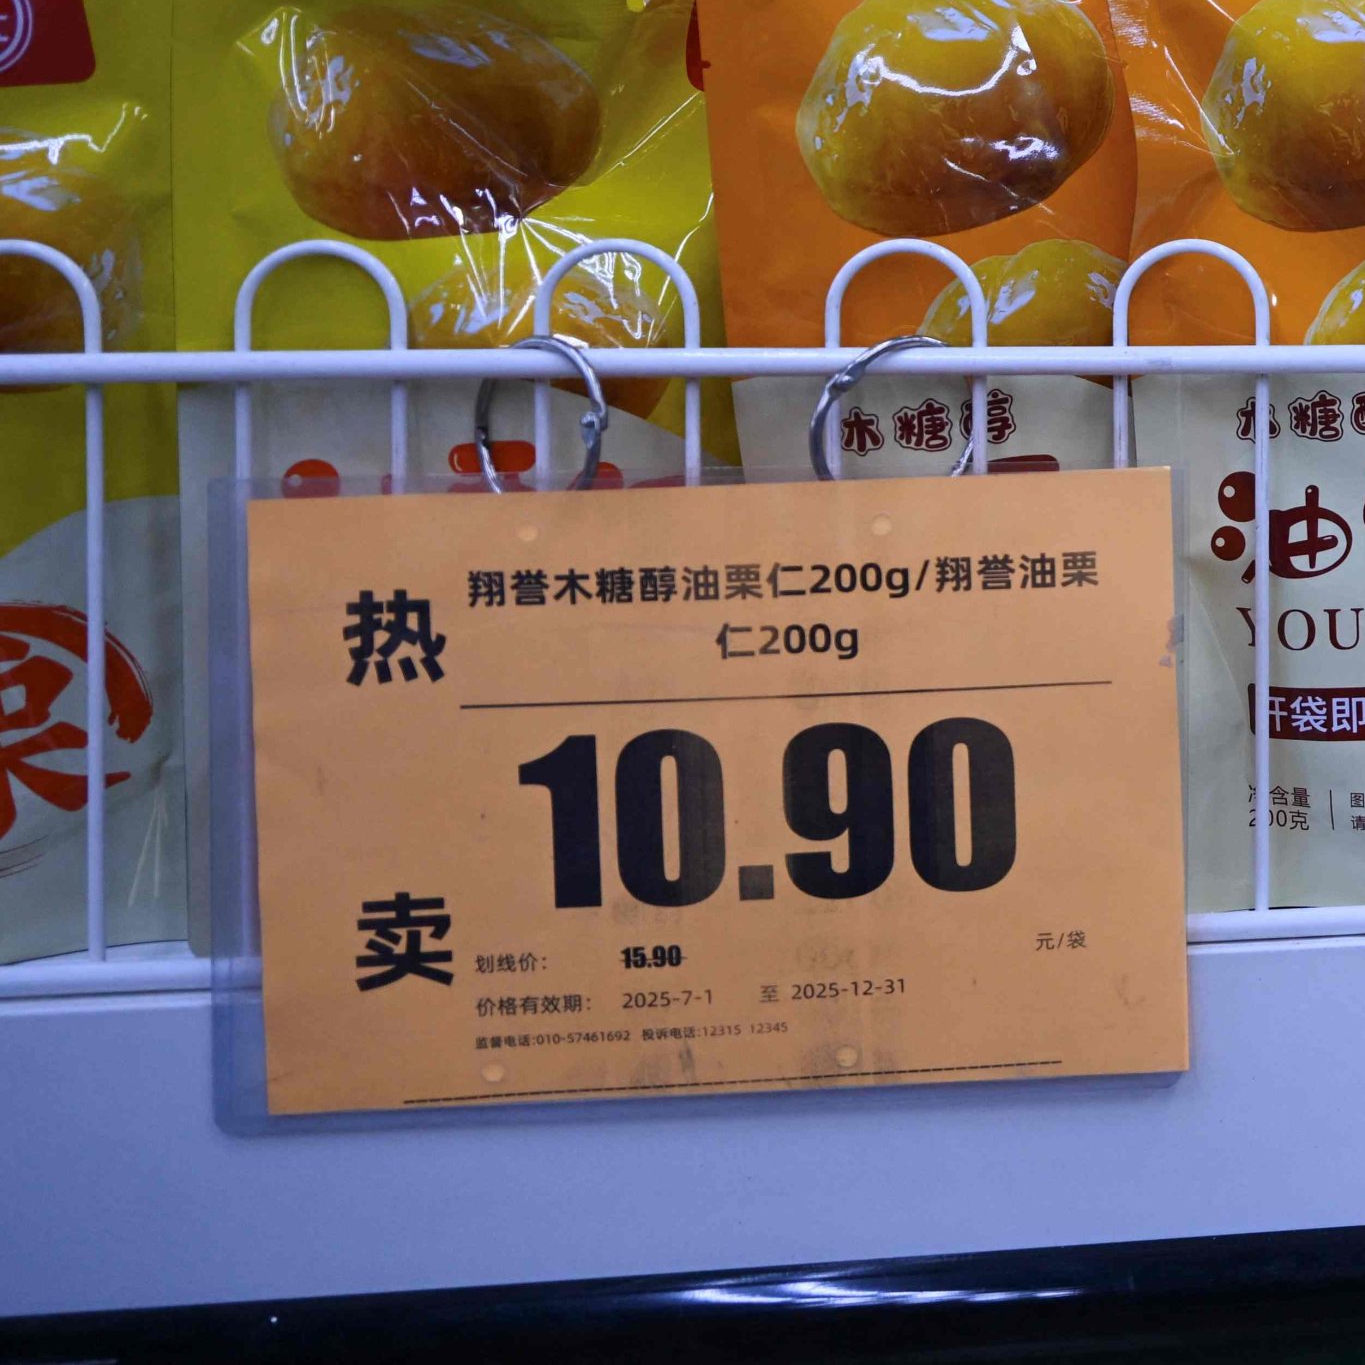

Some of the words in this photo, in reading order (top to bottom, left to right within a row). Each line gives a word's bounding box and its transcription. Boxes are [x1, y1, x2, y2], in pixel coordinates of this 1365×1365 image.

[467, 550, 1100, 608] 翔誉木糖醇油栗仁200g/翔誉油栗
[343, 588, 447, 687] 热
[715, 622, 860, 661] 仁200g
[516, 716, 1018, 909] 10.90
[354, 890, 455, 992] 卖
[620, 944, 684, 969] 15.90
[1035, 930, 1087, 951] 元/袋
[622, 988, 714, 1010] 2025-7-1
[759, 985, 780, 1004] 至
[791, 978, 906, 1001] 2025-12-31
[750, 1021, 789, 1035] 12345
